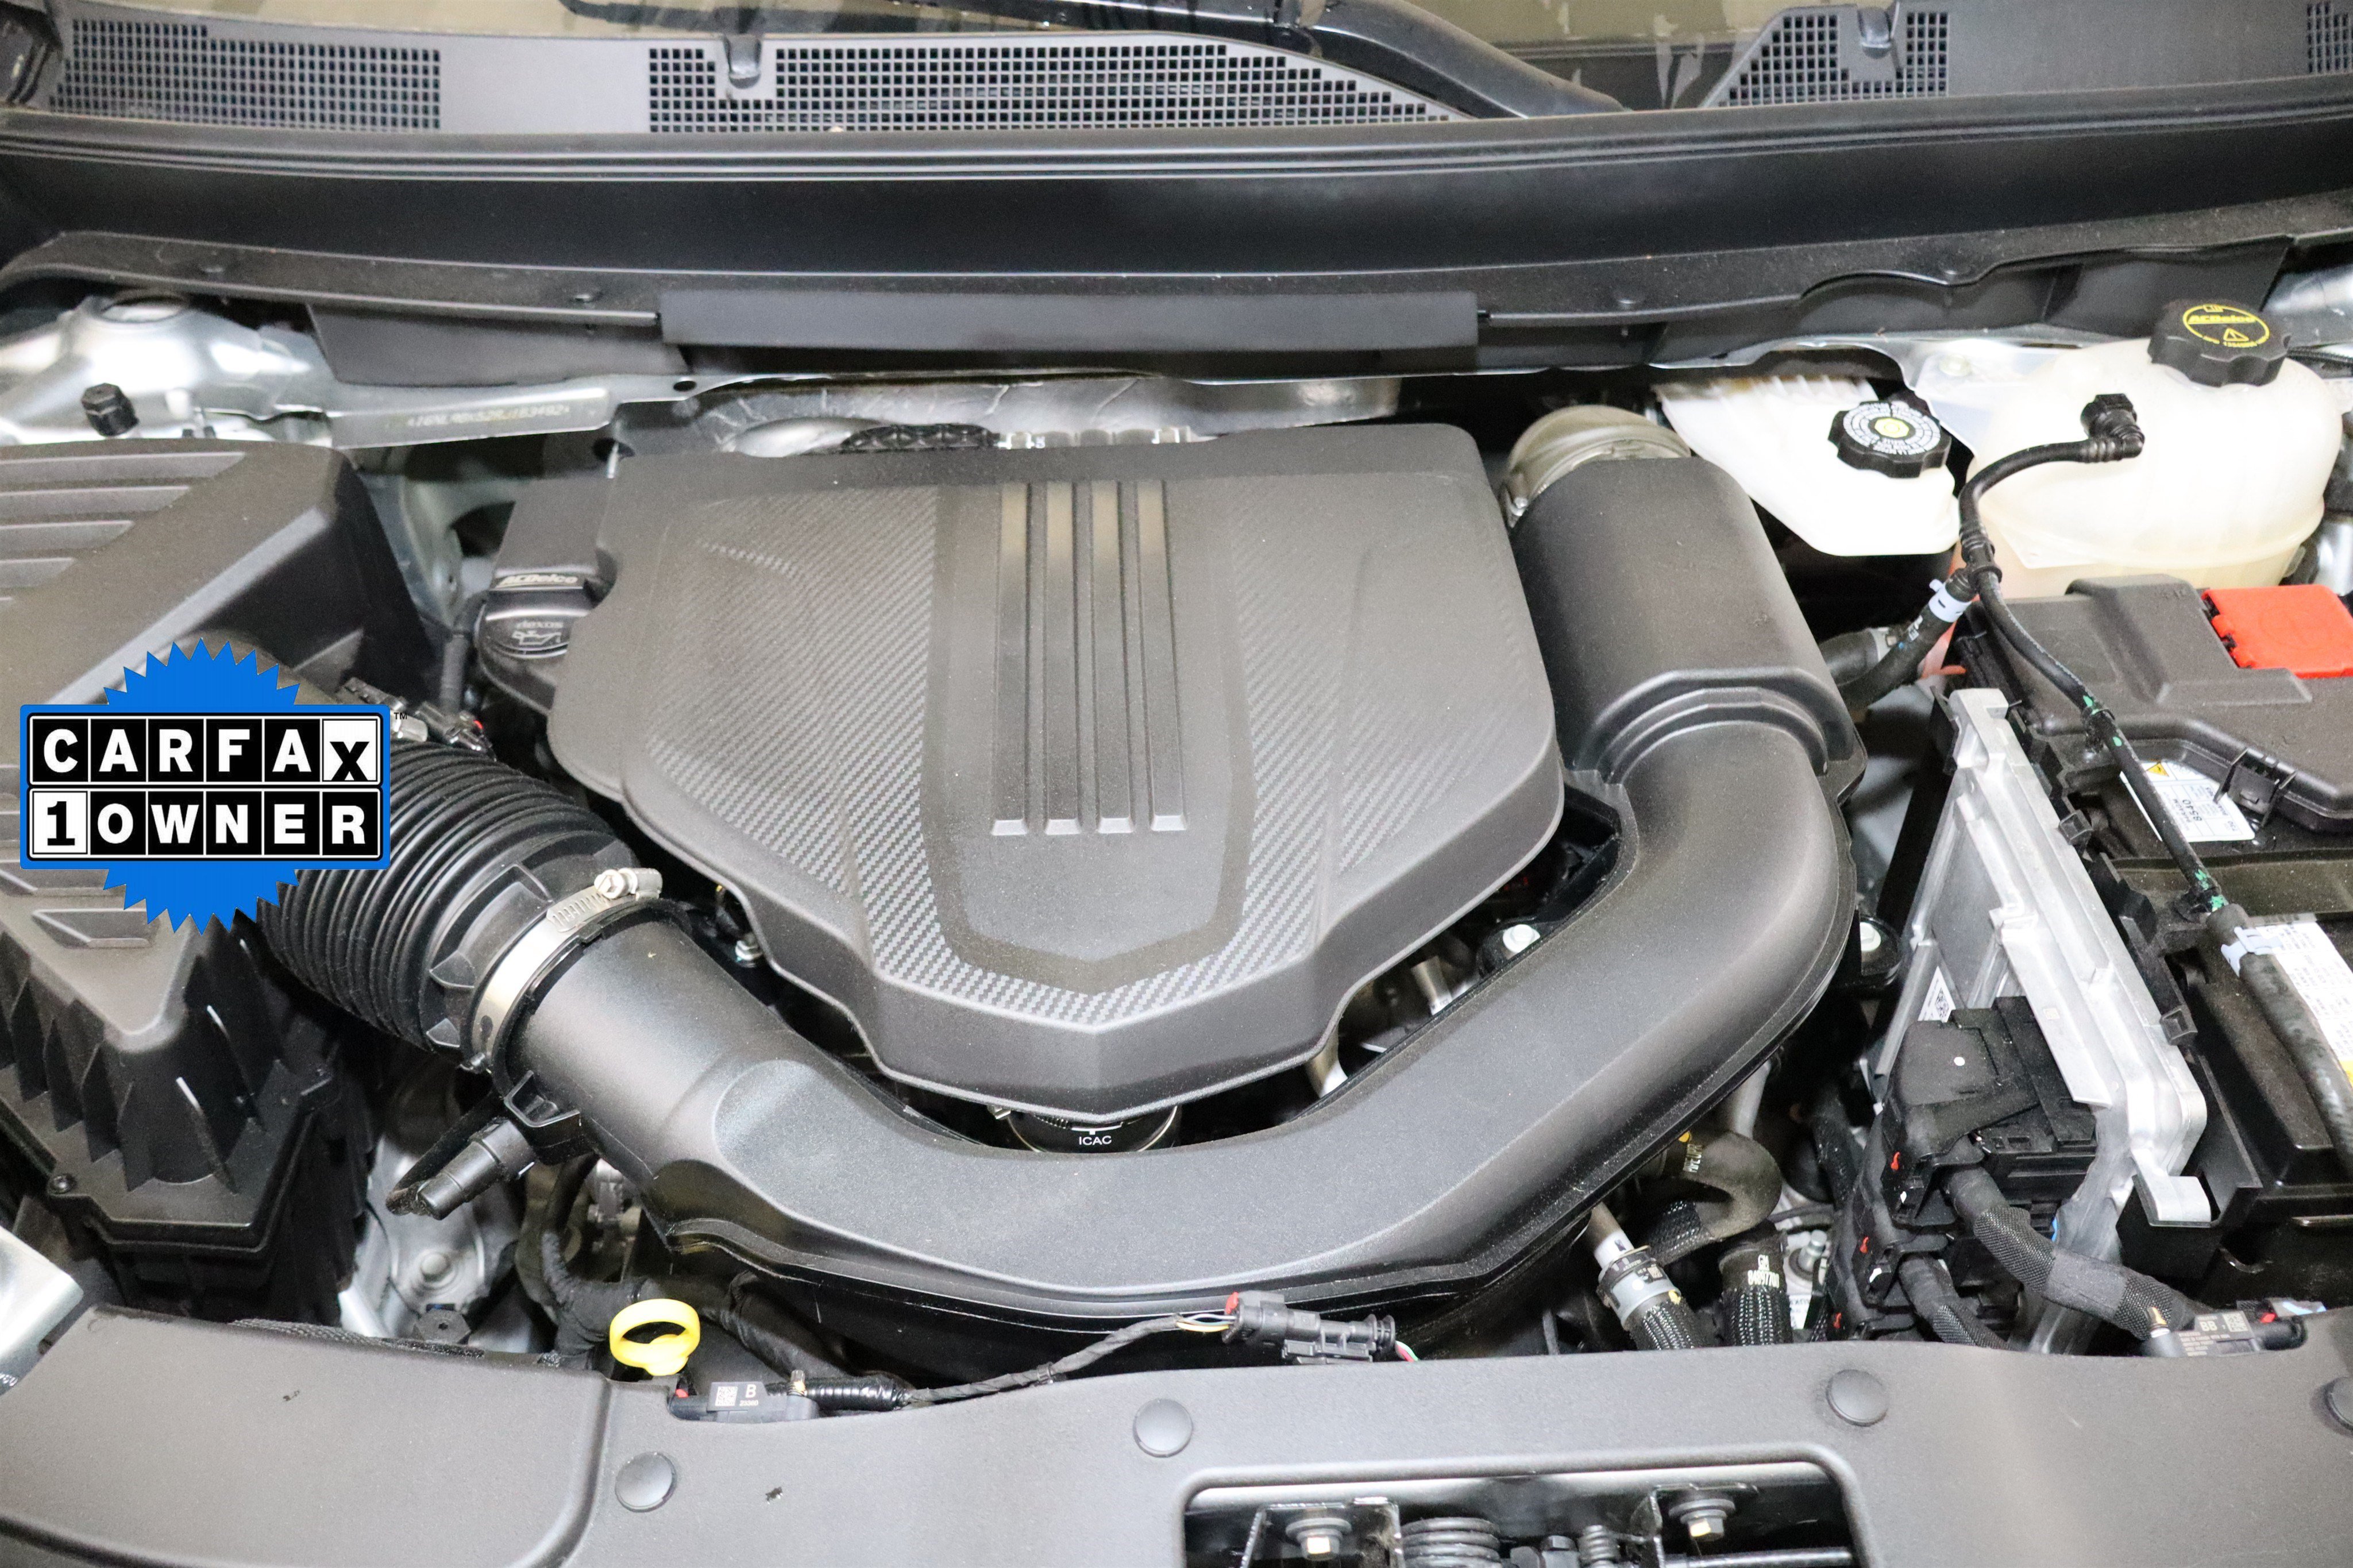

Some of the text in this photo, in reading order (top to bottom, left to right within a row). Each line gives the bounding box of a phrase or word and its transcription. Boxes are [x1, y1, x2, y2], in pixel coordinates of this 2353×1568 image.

[2189, 315, 2256, 324] ACDelco
[496, 574, 578, 588] ACDelco
[1079, 1135, 1112, 1146] ICAC
[1758, 1254, 1770, 1270] GM
[2200, 1320, 2217, 1331] BB
[746, 1384, 757, 1398] B
